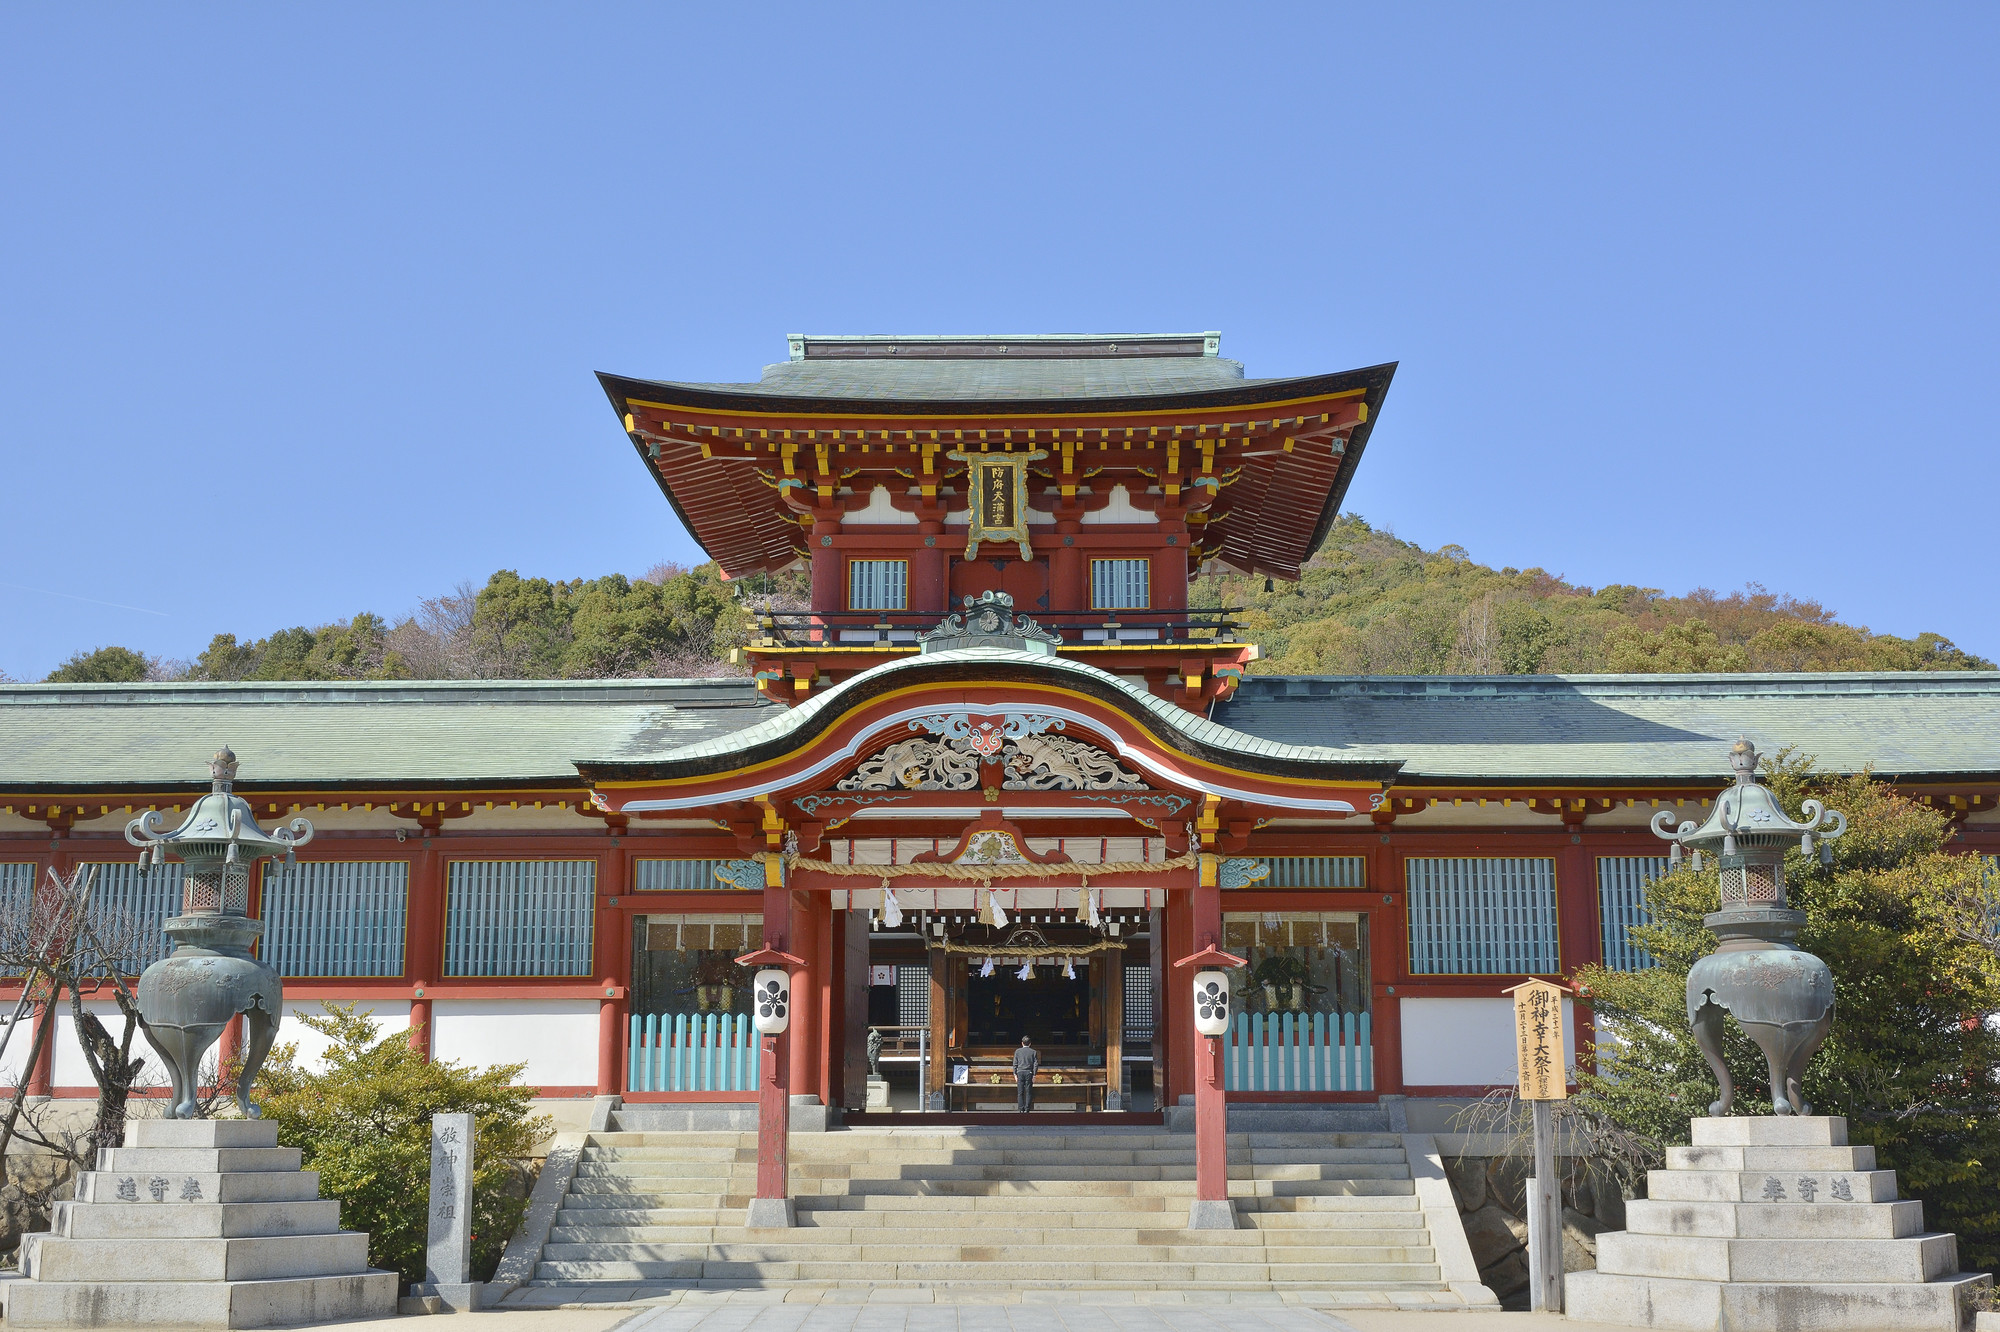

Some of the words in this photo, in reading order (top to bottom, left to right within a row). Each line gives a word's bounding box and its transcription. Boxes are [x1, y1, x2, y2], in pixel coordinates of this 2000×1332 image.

[992, 467, 1005, 525] 防府天満宮
[1550, 996, 1560, 1039] 平成三十一年
[437, 1126, 461, 1219] 敬神崇祖
